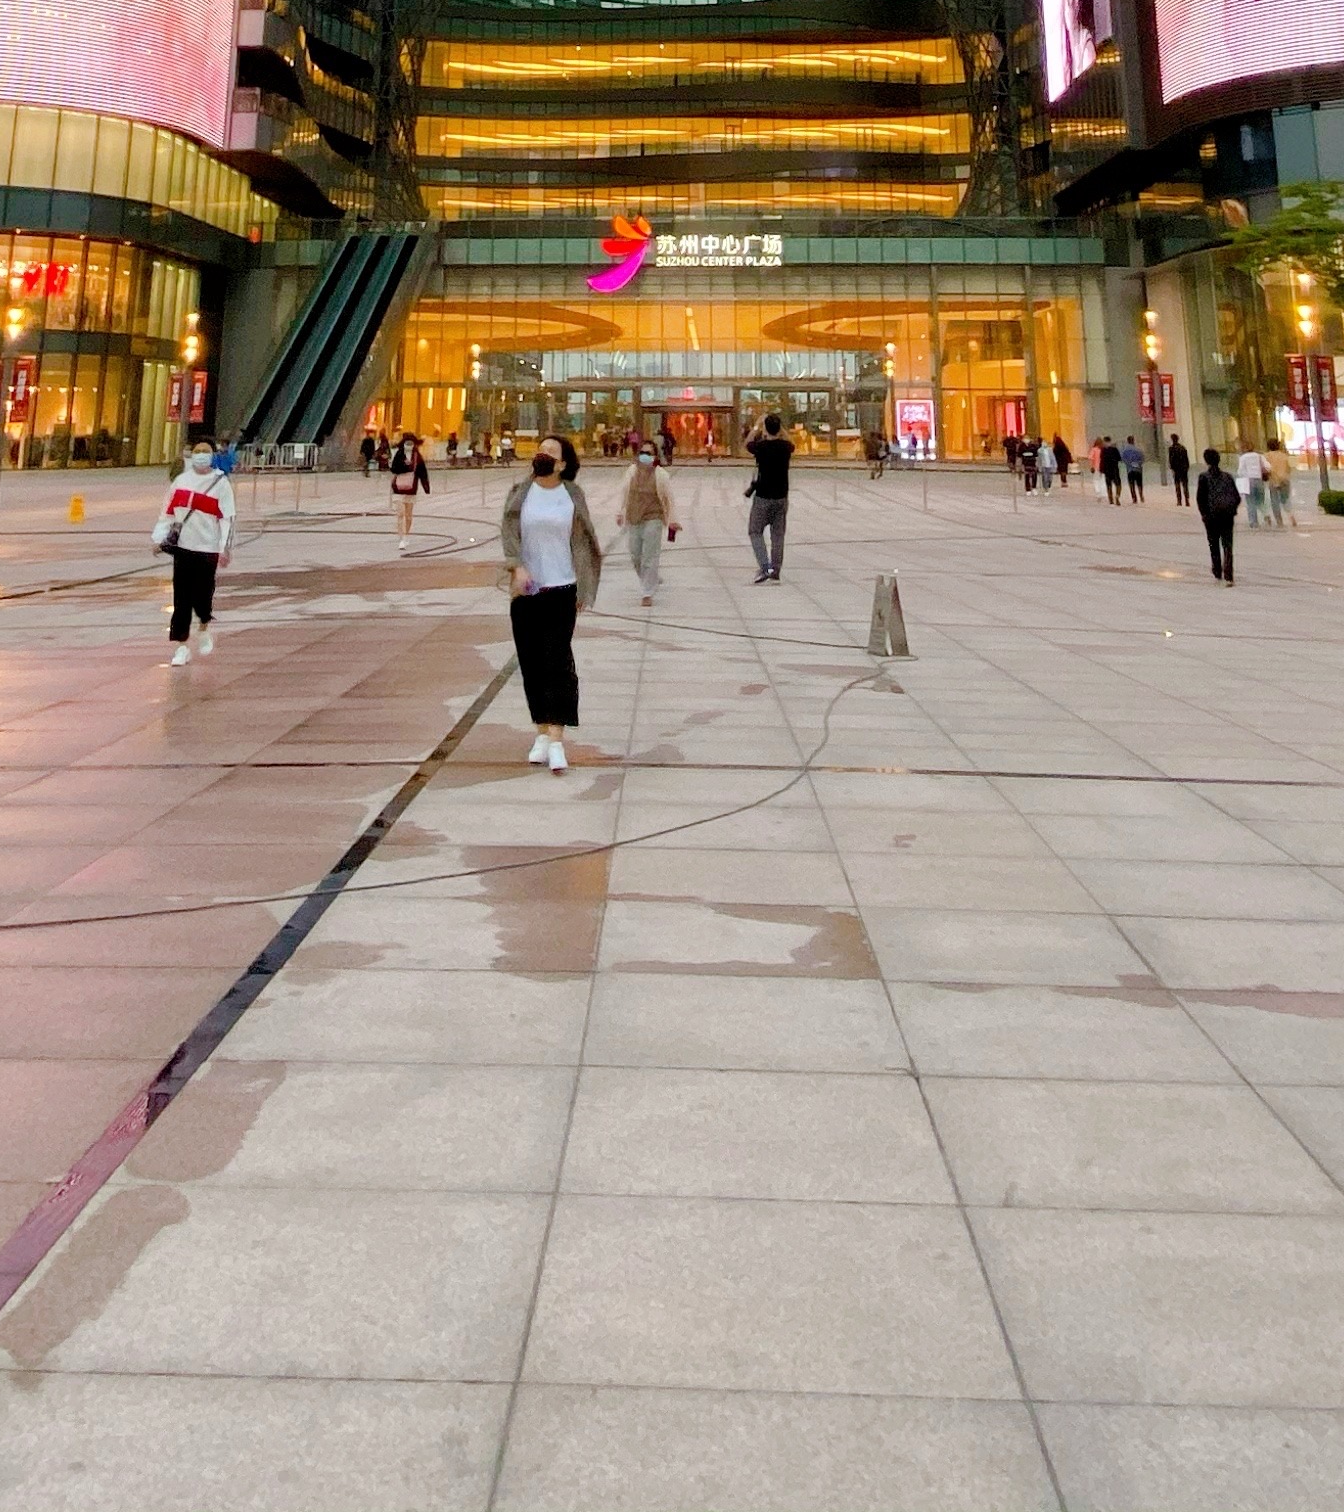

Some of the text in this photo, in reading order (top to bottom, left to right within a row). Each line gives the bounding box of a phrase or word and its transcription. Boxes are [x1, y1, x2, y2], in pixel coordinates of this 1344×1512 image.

[656, 234, 782, 255] 苏州中心广场
[656, 256, 782, 267] SUZHOU CENTER PLAZA
